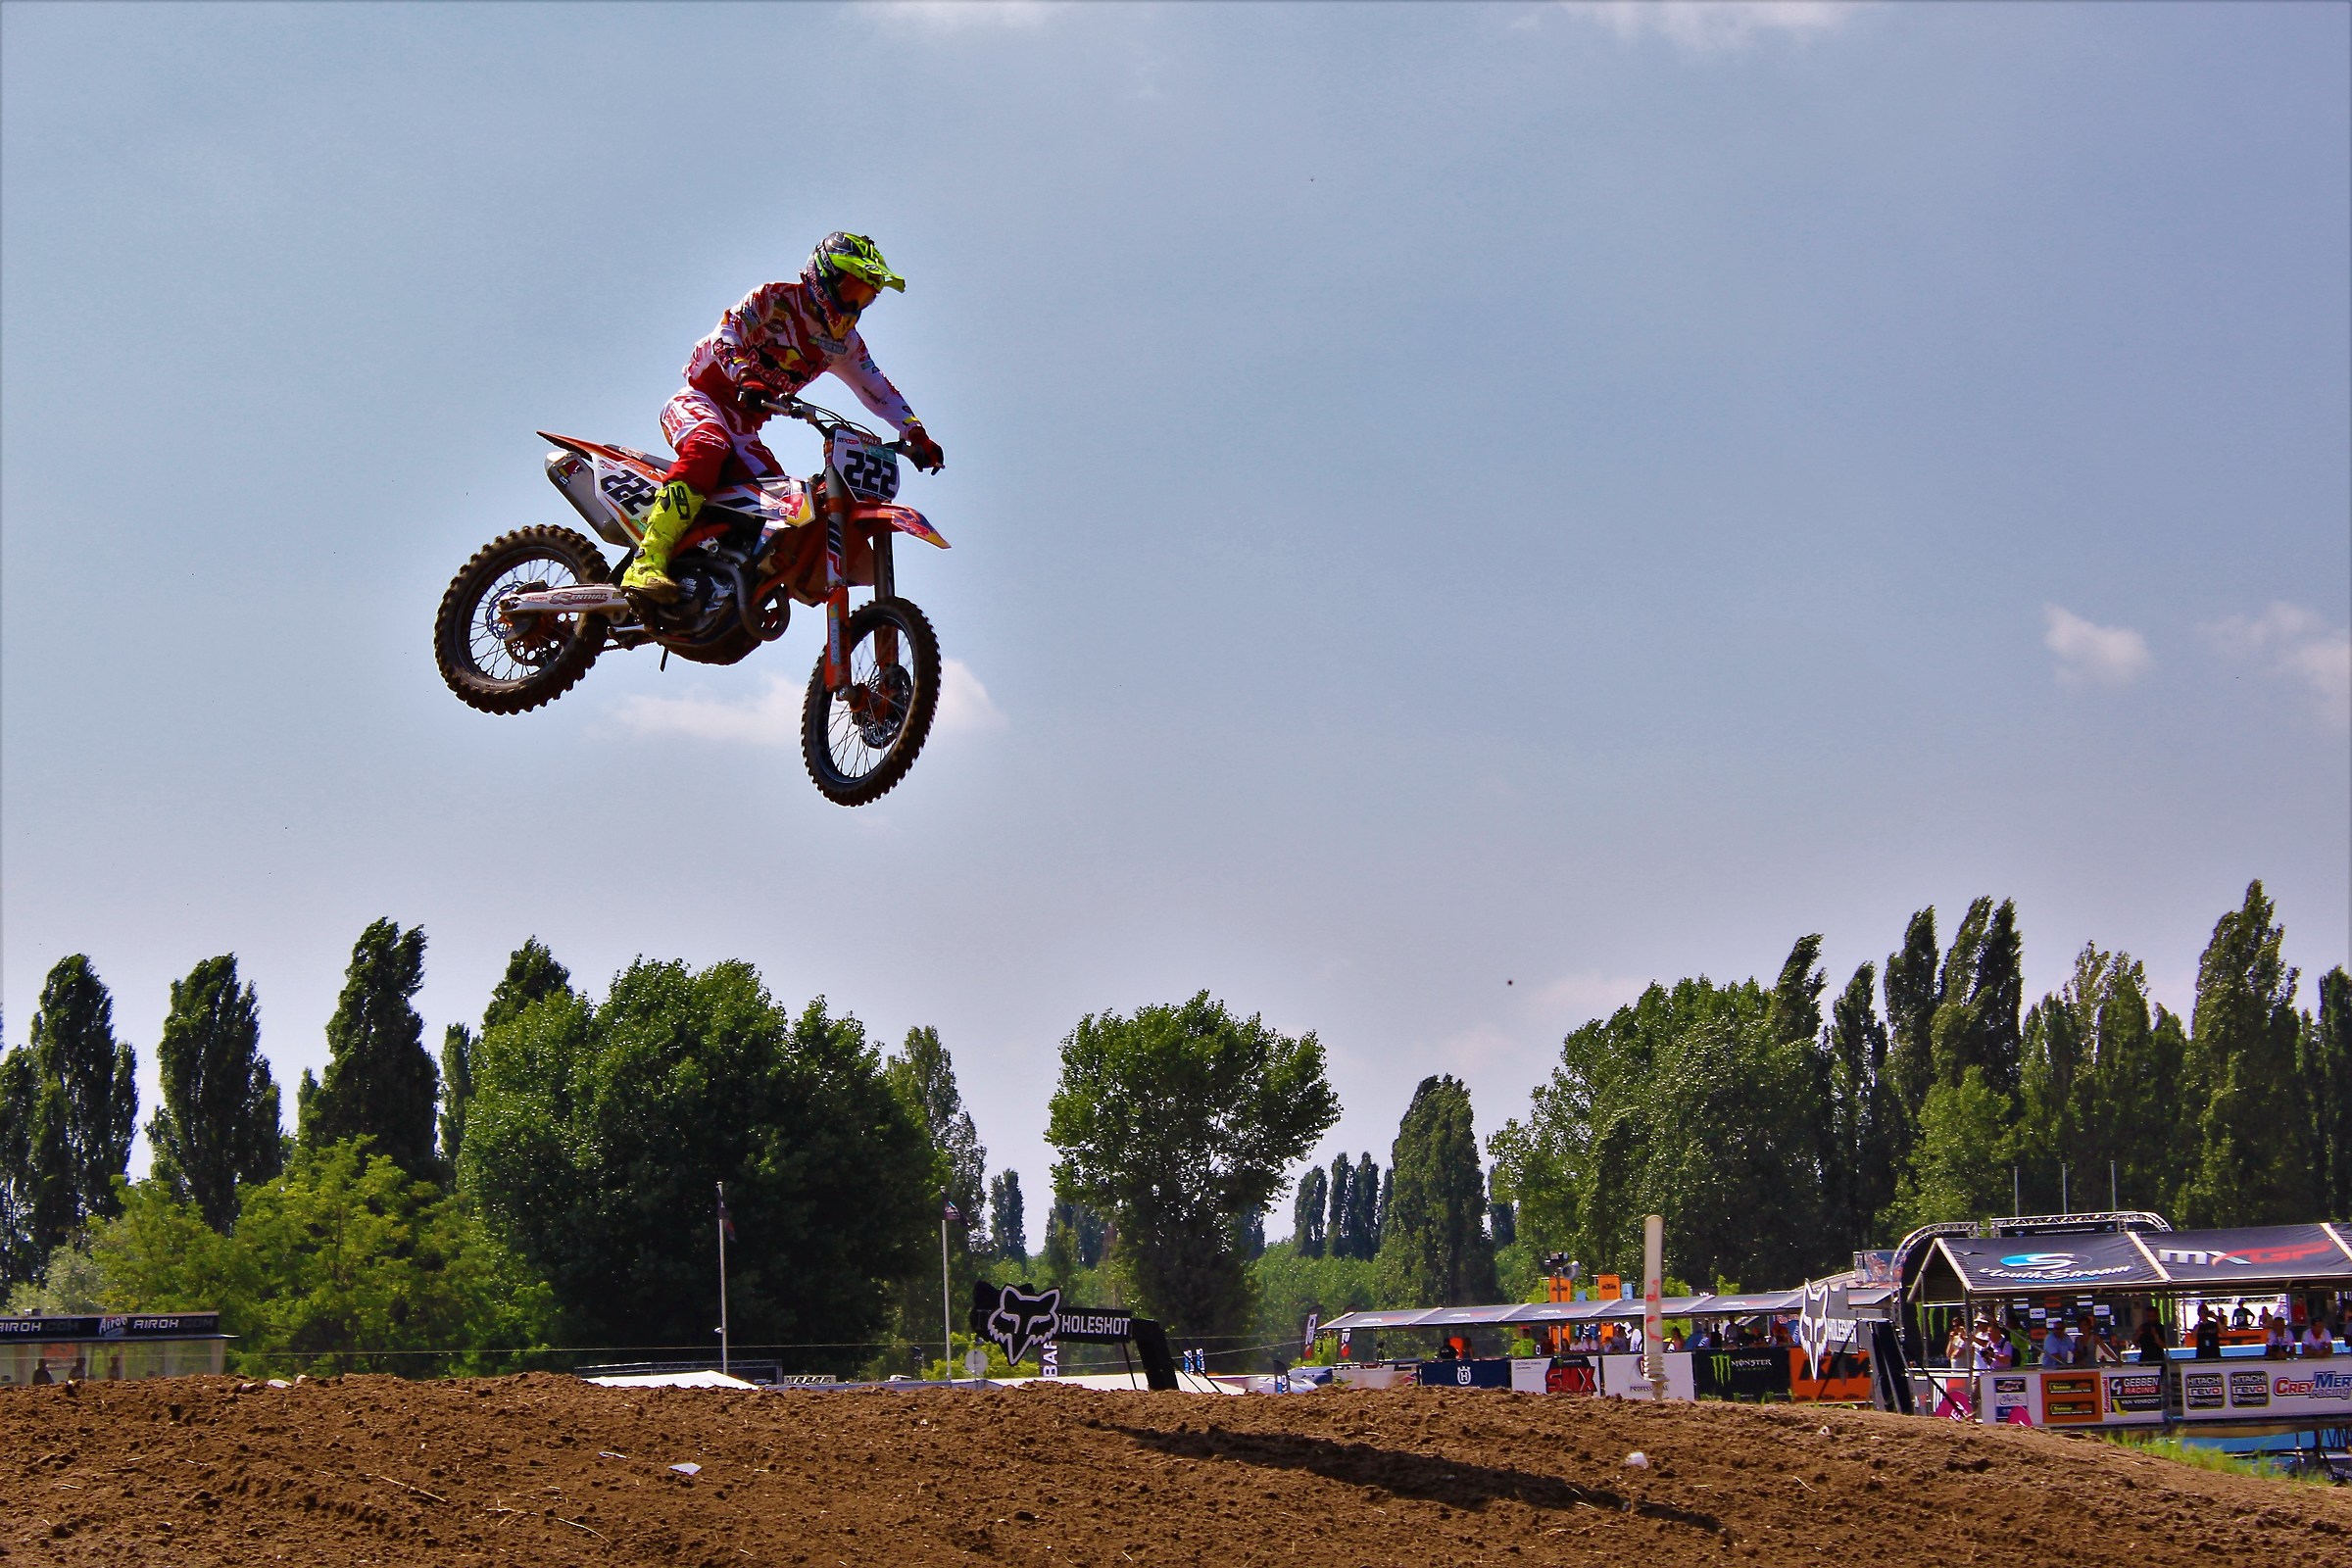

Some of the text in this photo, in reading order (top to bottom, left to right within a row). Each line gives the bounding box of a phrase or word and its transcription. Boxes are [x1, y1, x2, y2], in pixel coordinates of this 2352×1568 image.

[843, 450, 898, 500] 222
[550, 591, 609, 606] RENTHAL
[1061, 1314, 1131, 1336] HOLESHOT
[1731, 1358, 1773, 1367] MONSTER
[1545, 1366, 1597, 1394] SMX
[2124, 1377, 2159, 1387] GEBBEN
[2186, 1376, 2222, 1386] HITACHI
[2231, 1375, 2266, 1384] HITACHI
